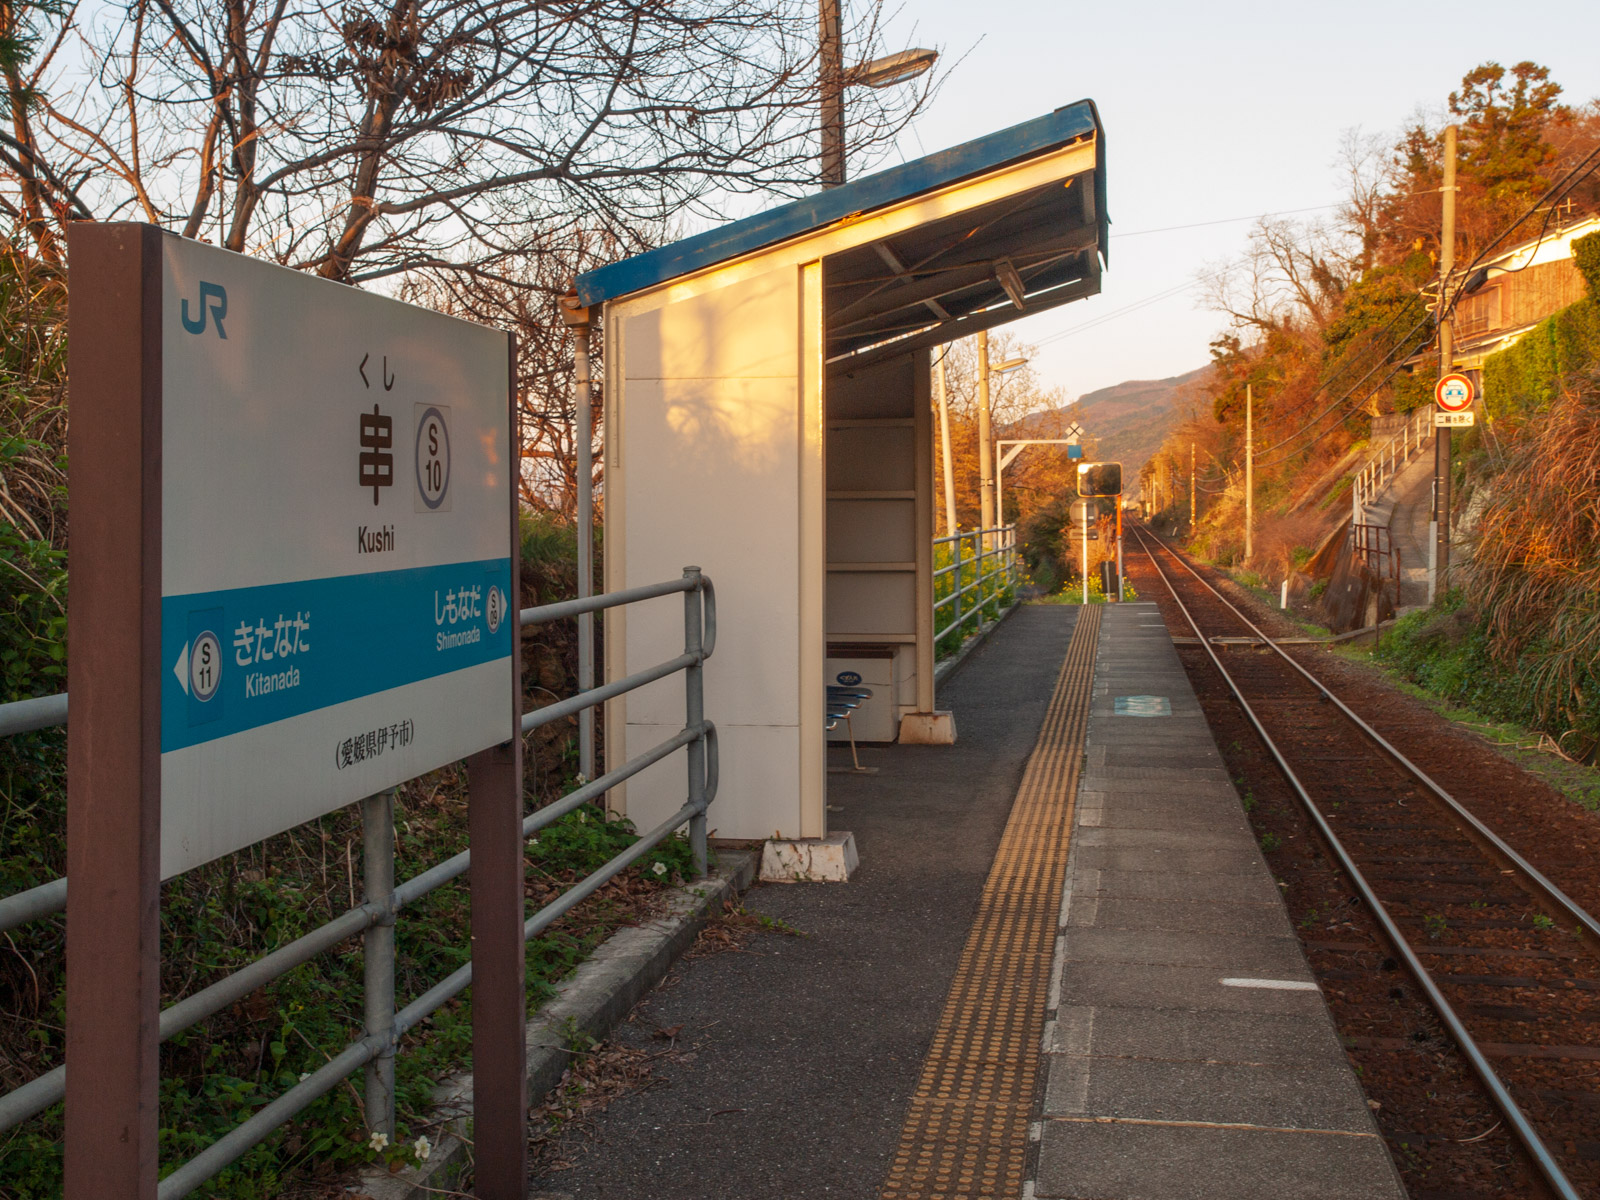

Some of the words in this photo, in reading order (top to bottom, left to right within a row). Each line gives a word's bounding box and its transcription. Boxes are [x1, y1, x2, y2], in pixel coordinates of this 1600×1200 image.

[180, 280, 228, 340] JR
[358, 351, 395, 392] くし
[358, 403, 394, 506] 串
[427, 422, 439, 457] S
[425, 459, 442, 493] 10
[357, 524, 395, 554] Kushi
[434, 584, 482, 626] しもなだ
[491, 593, 497, 609] S
[200, 642, 212, 666] S
[232, 610, 311, 667] きたなだ
[436, 625, 481, 652] Shimonada
[198, 665, 213, 690] 11
[245, 665, 300, 699] Kitanada
